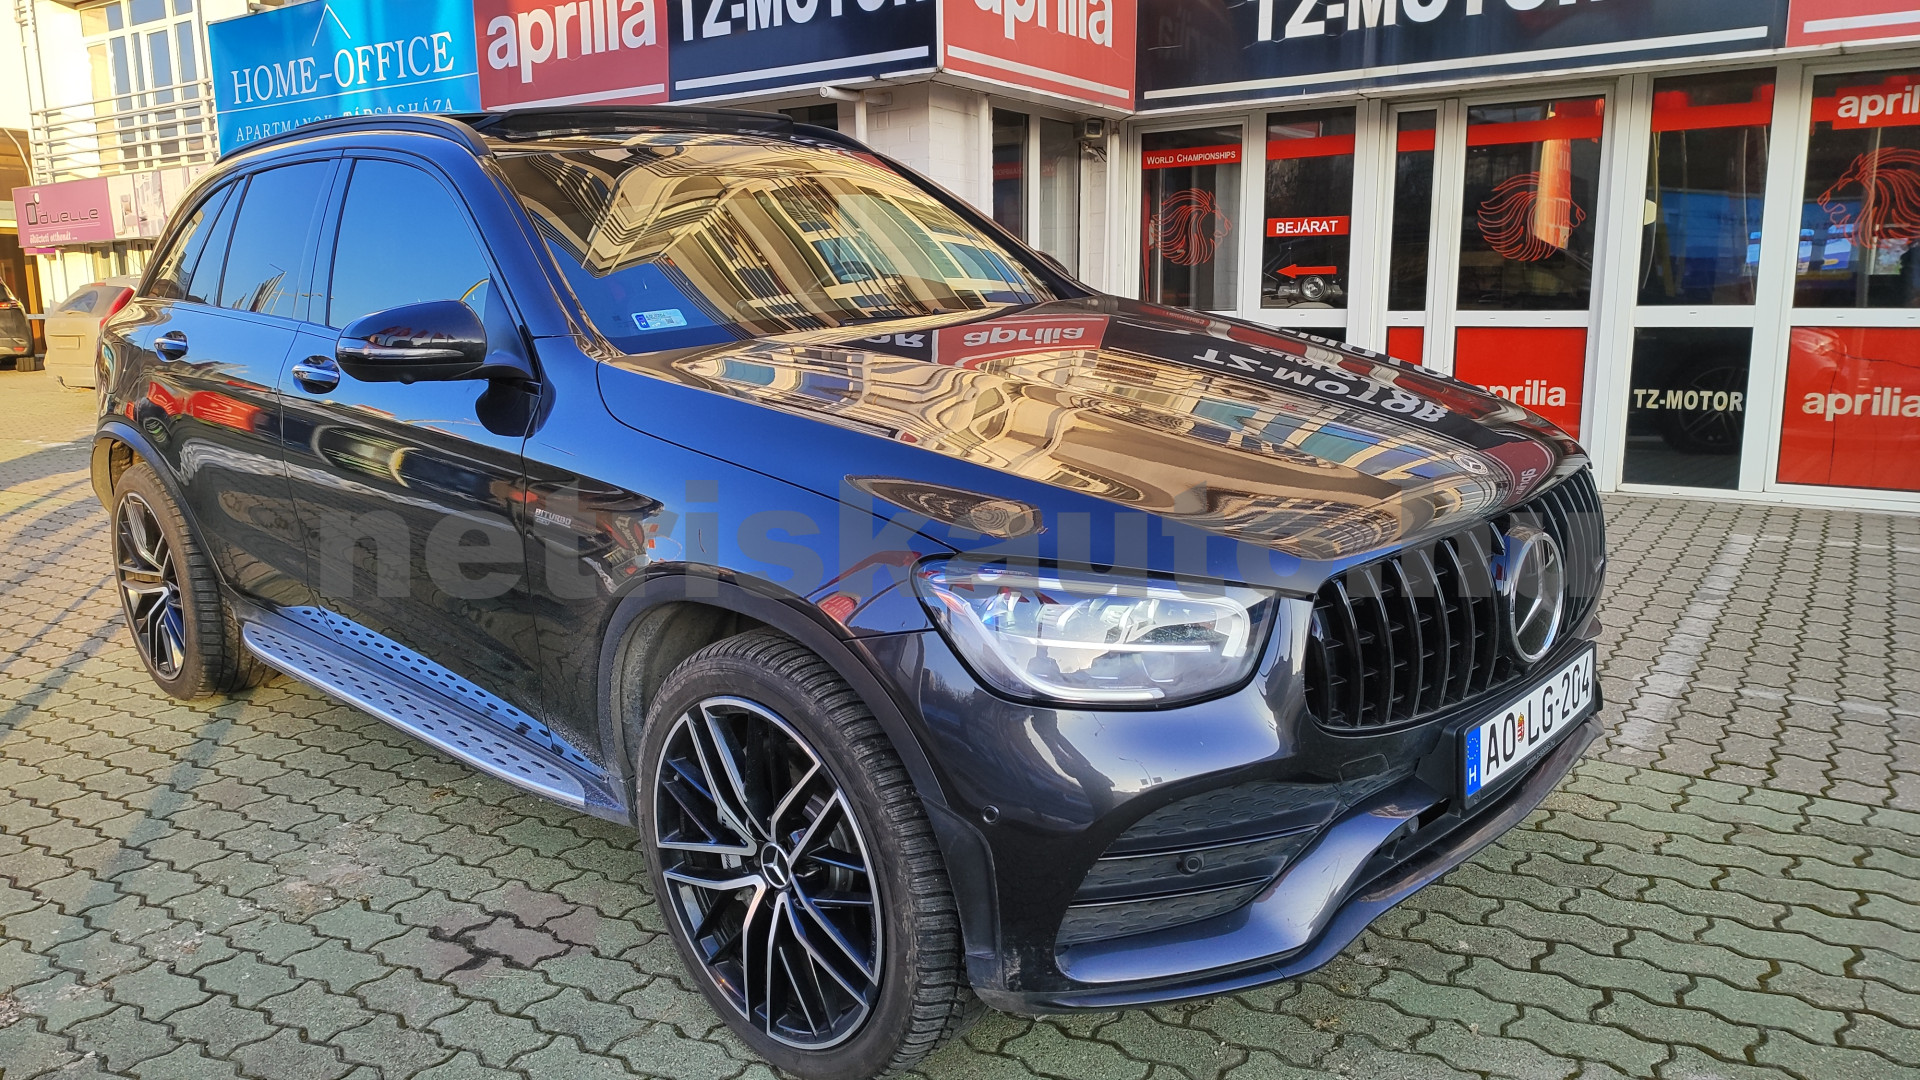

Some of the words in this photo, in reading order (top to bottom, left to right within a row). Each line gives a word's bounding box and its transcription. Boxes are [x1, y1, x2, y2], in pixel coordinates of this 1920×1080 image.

[681, 0, 927, 42] TZ-M
[974, 0, 1113, 48] prilia
[1247, 0, 1608, 42] TZ-M
[486, 0, 656, 84] aprilia
[230, 31, 454, 105] HOME-OFFICE
[236, 114, 333, 142] APARTMA
[1147, 154, 1175, 165] WORLD
[1176, 150, 1236, 163] CHAMPIONSHIPS
[1276, 219, 1339, 234] BEJÁRAT
[1474, 379, 1566, 407] prilia
[1633, 389, 1744, 412] TZ-MOTOR
[1802, 387, 1920, 421] aprilia
[535, 508, 572, 526] BITURBO
[1468, 764, 1477, 786] H
